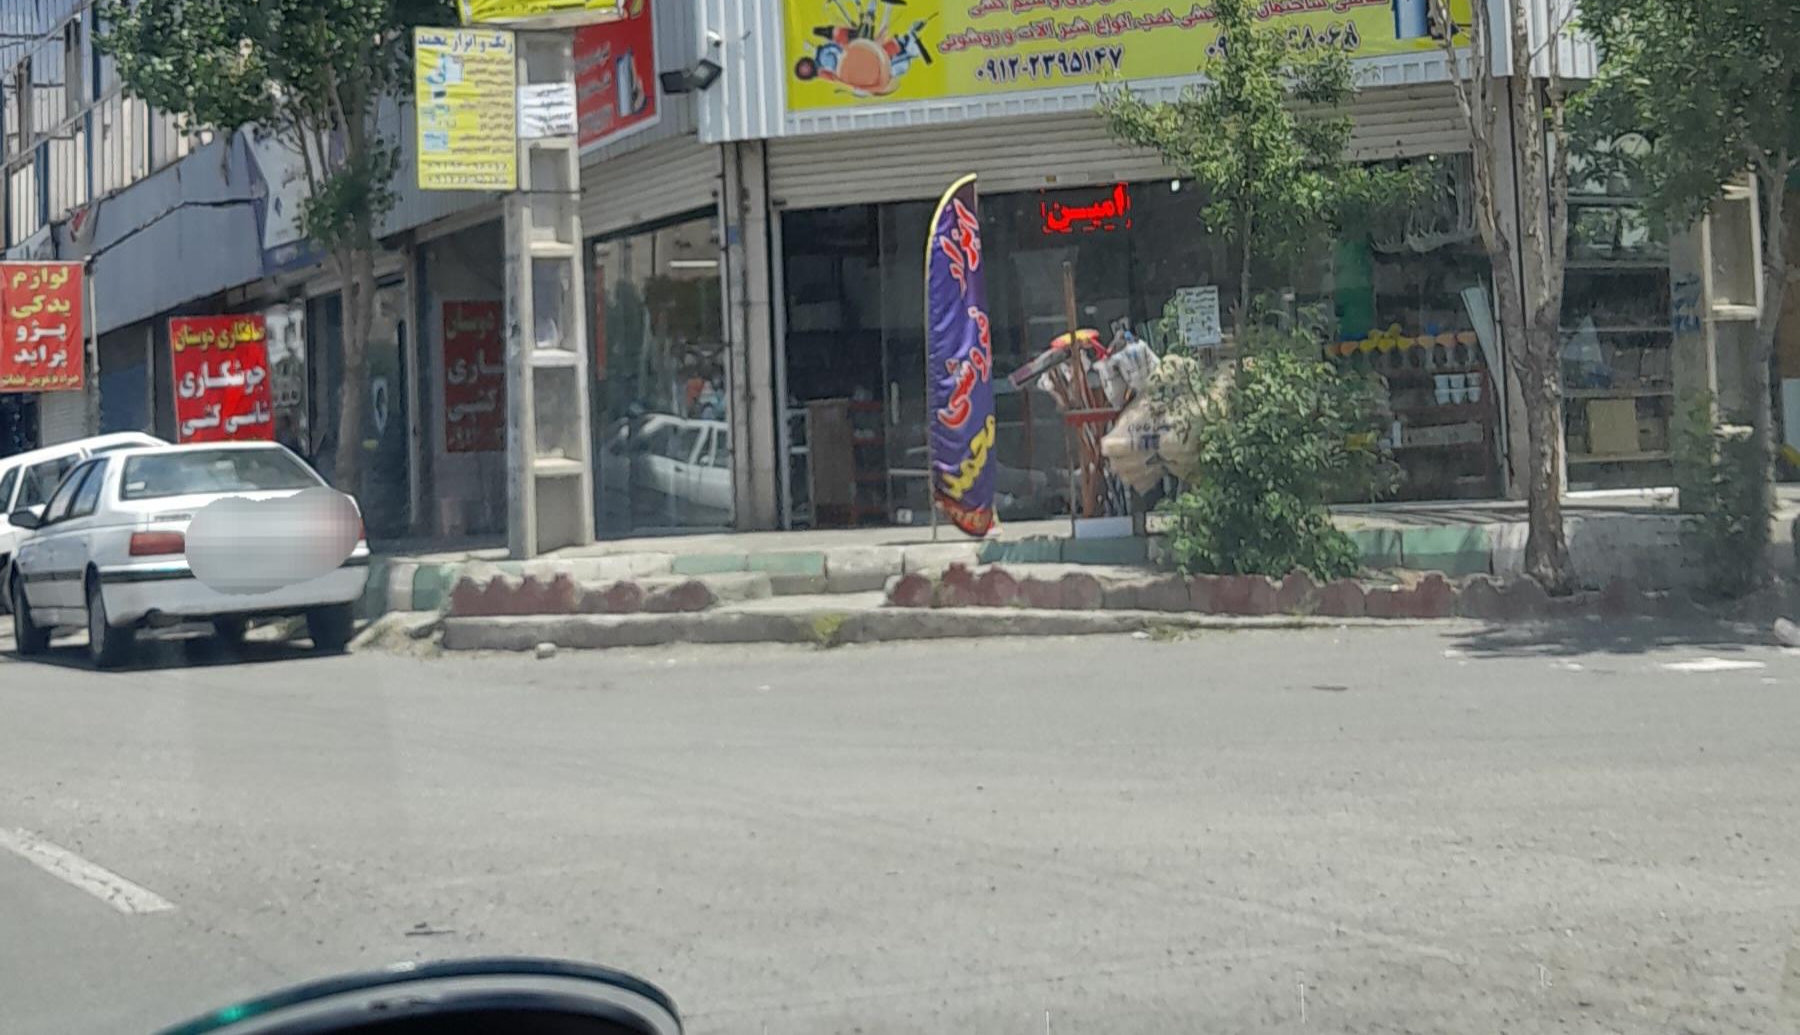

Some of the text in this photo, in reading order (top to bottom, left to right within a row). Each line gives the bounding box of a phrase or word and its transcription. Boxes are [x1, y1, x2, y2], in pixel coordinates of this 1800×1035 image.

[1094, 11, 1134, 38] انواع
[1134, 8, 1177, 31] نصب
[1001, 28, 1016, 45] و
[976, 45, 1124, 82] ۰۹۱۲-۲۳۹۵۱۴۷
[1047, 182, 1126, 231] امین
[12, 265, 69, 290] لوازم
[10, 294, 71, 319] یدکی
[15, 319, 68, 343] پژو
[175, 324, 215, 352] دوستان
[13, 344, 68, 368] پراید
[179, 359, 266, 398] جوشکاری
[181, 400, 271, 436] شاسی کشی
